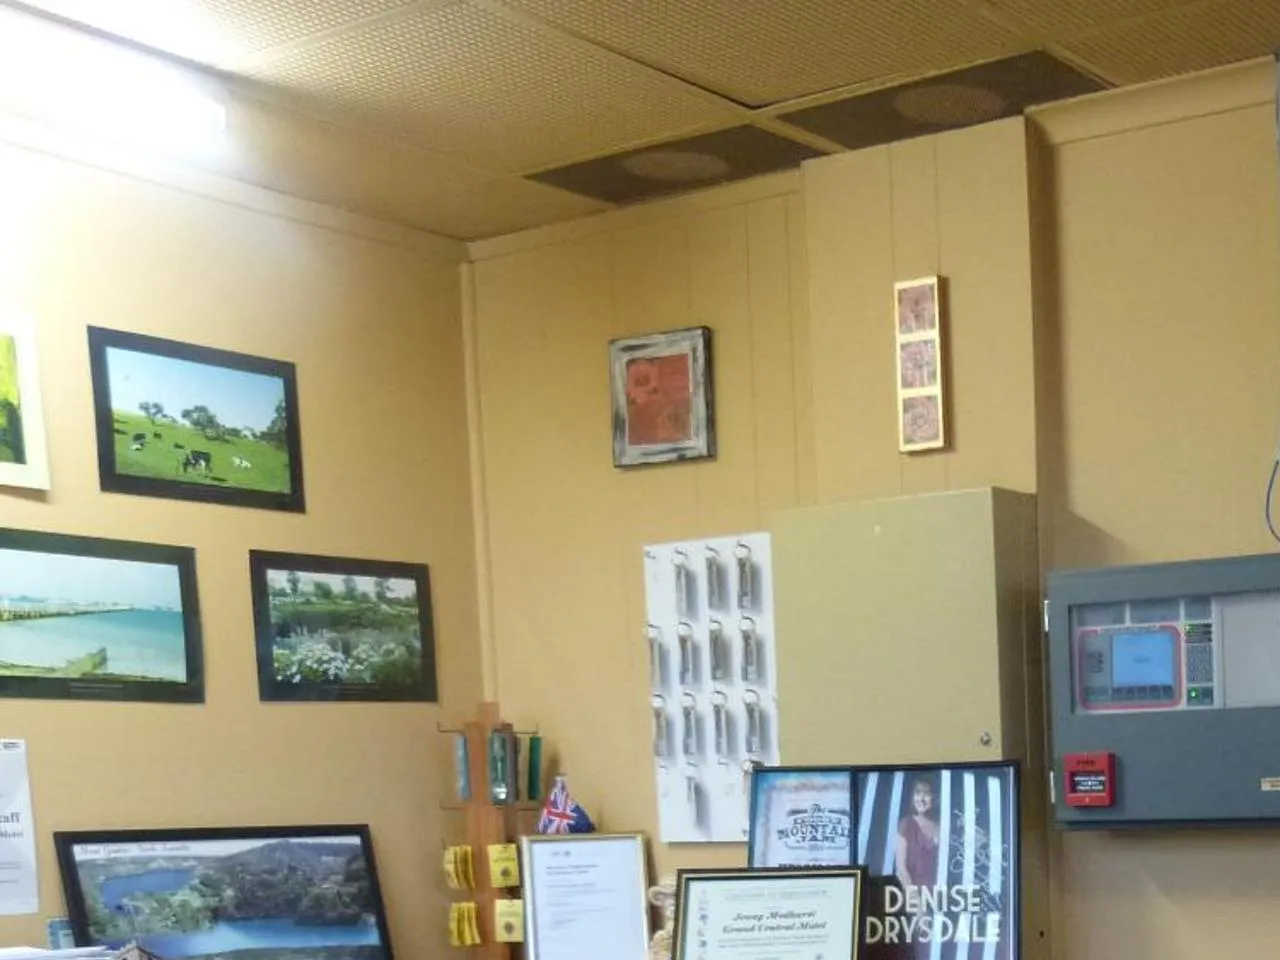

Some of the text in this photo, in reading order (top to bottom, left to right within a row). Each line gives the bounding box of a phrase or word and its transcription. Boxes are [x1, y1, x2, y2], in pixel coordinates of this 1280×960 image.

[777, 823, 850, 840] MOUNTAI
[884, 884, 981, 913] DENISE
[864, 912, 1001, 944] DRYSDALE
